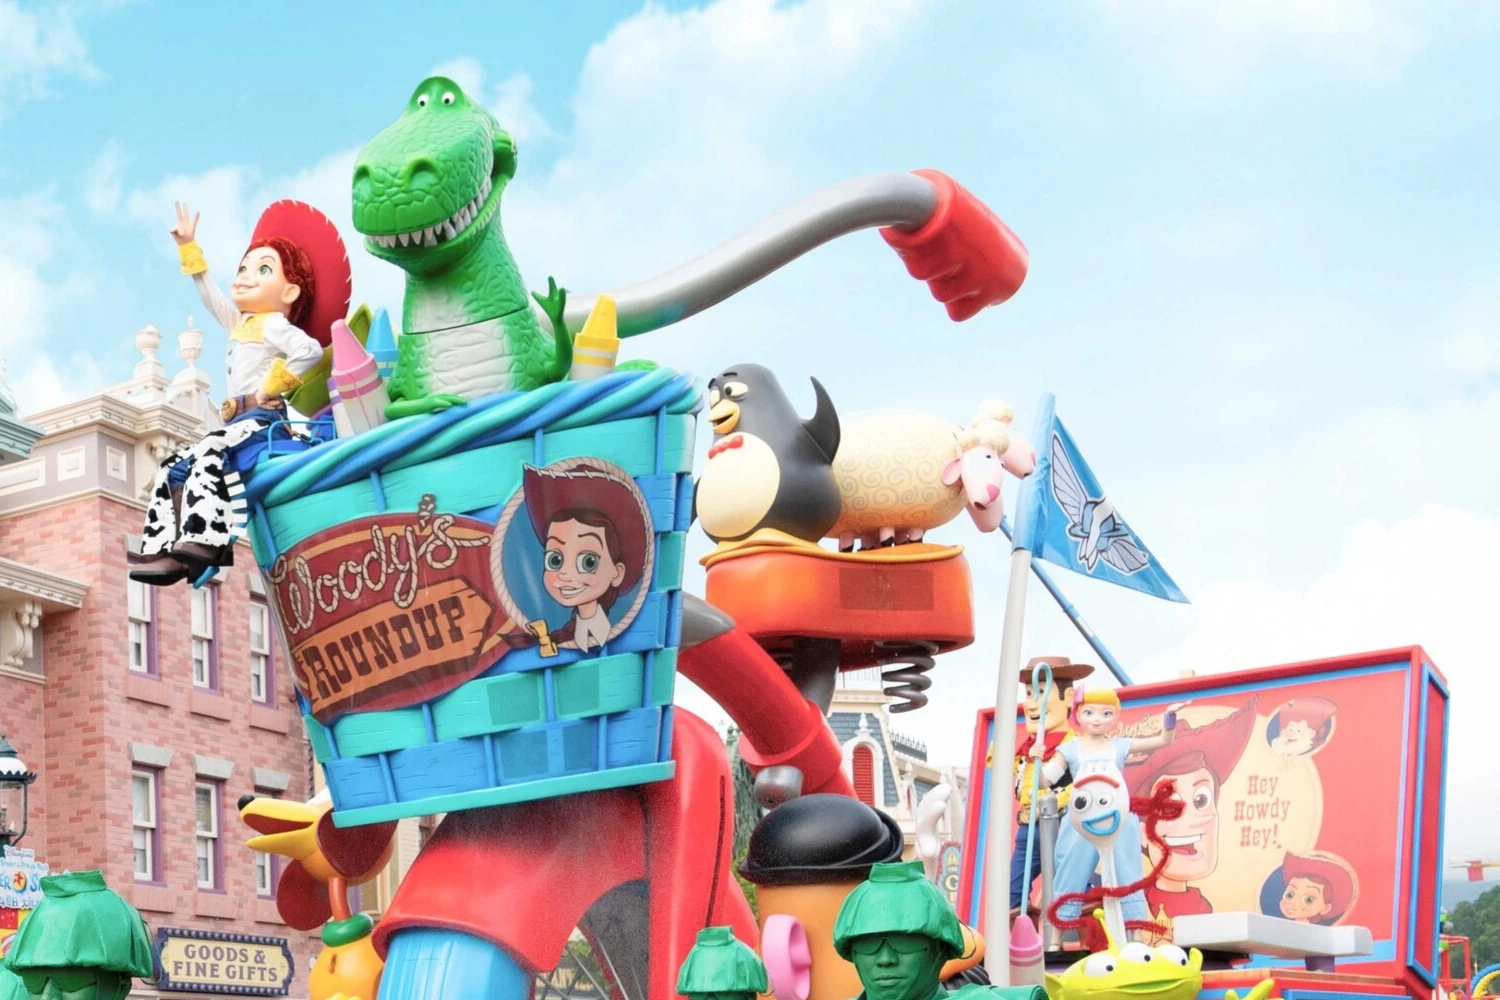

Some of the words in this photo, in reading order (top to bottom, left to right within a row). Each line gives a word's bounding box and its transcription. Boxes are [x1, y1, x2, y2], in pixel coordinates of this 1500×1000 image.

[268, 494, 490, 634] Woody's
[302, 595, 466, 701] ROUNDUP
[1248, 775, 1279, 797] Hey
[1234, 797, 1291, 821] Howdy
[1240, 824, 1278, 849] Hey!
[184, 944, 249, 963] GOODS
[254, 950, 266, 964] &
[173, 961, 220, 978] FINE
[225, 964, 278, 982] GIFTS
